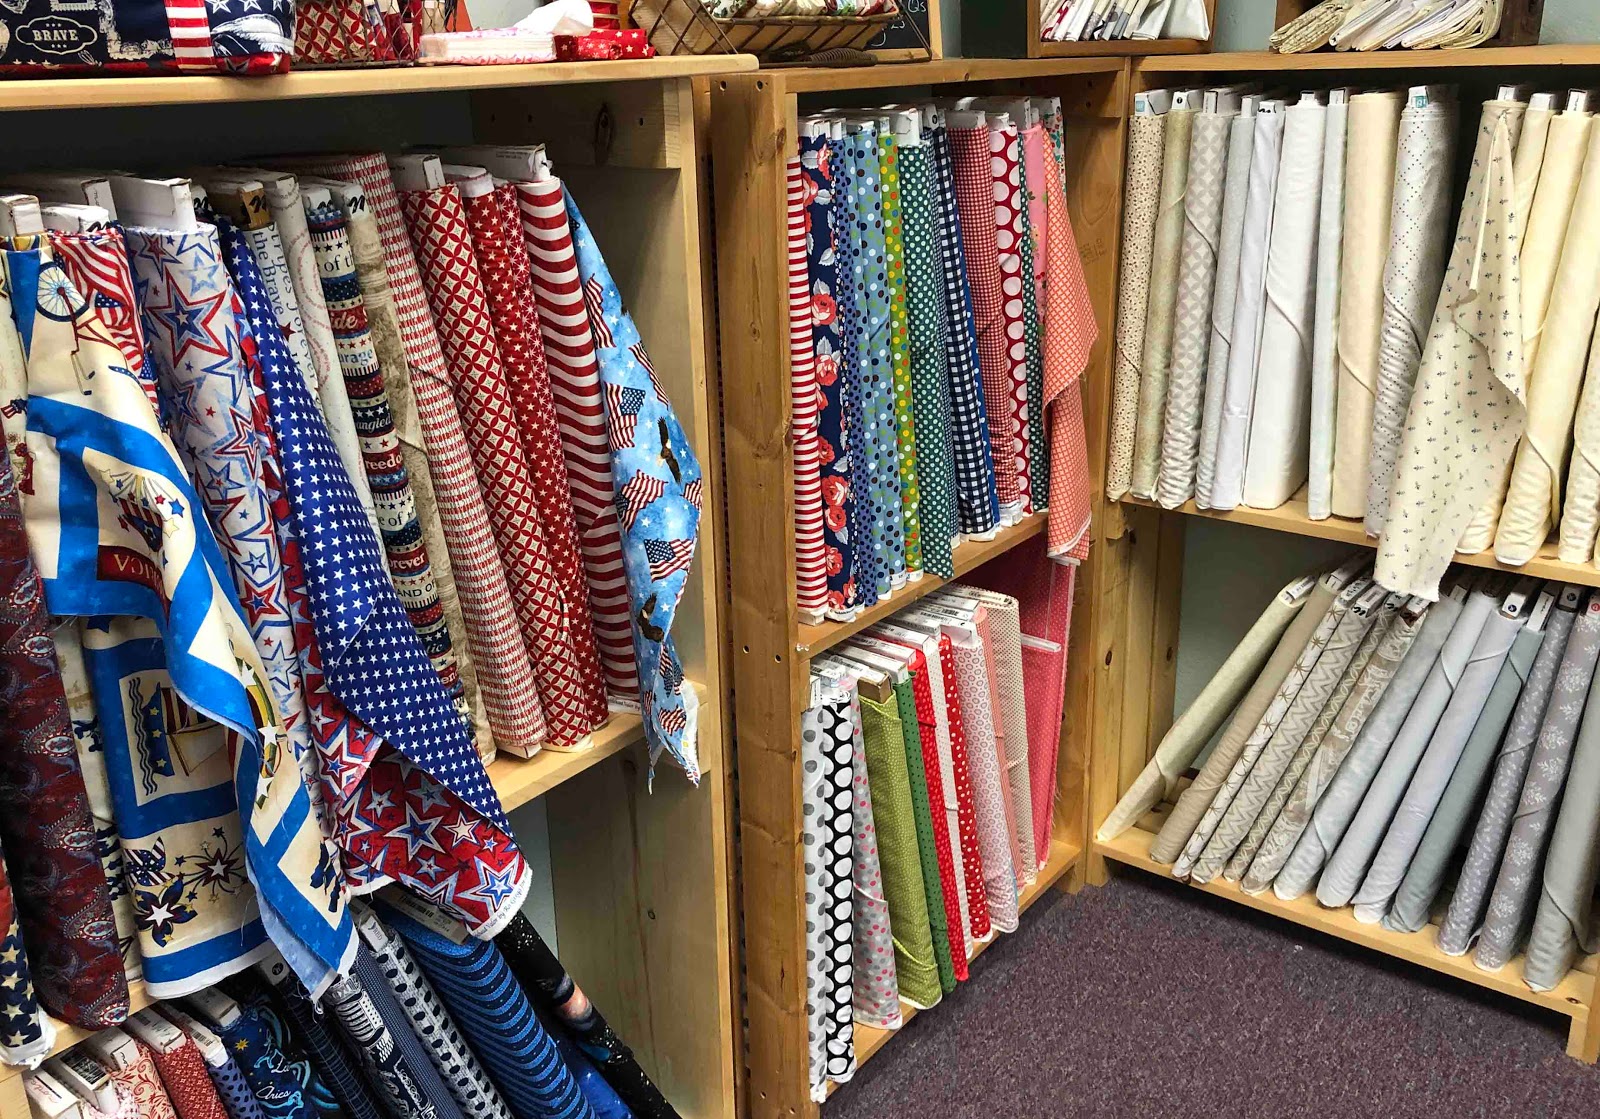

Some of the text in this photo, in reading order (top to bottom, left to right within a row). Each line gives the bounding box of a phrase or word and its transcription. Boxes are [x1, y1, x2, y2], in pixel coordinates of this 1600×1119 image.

[32, 29, 79, 41] BRAVE
[324, 254, 341, 273] of
[252, 231, 284, 315] the Brave
[332, 310, 358, 329] ide
[366, 453, 404, 470] reedo
[388, 511, 403, 527] of
[389, 552, 426, 570] orever
[397, 587, 422, 599] AND
